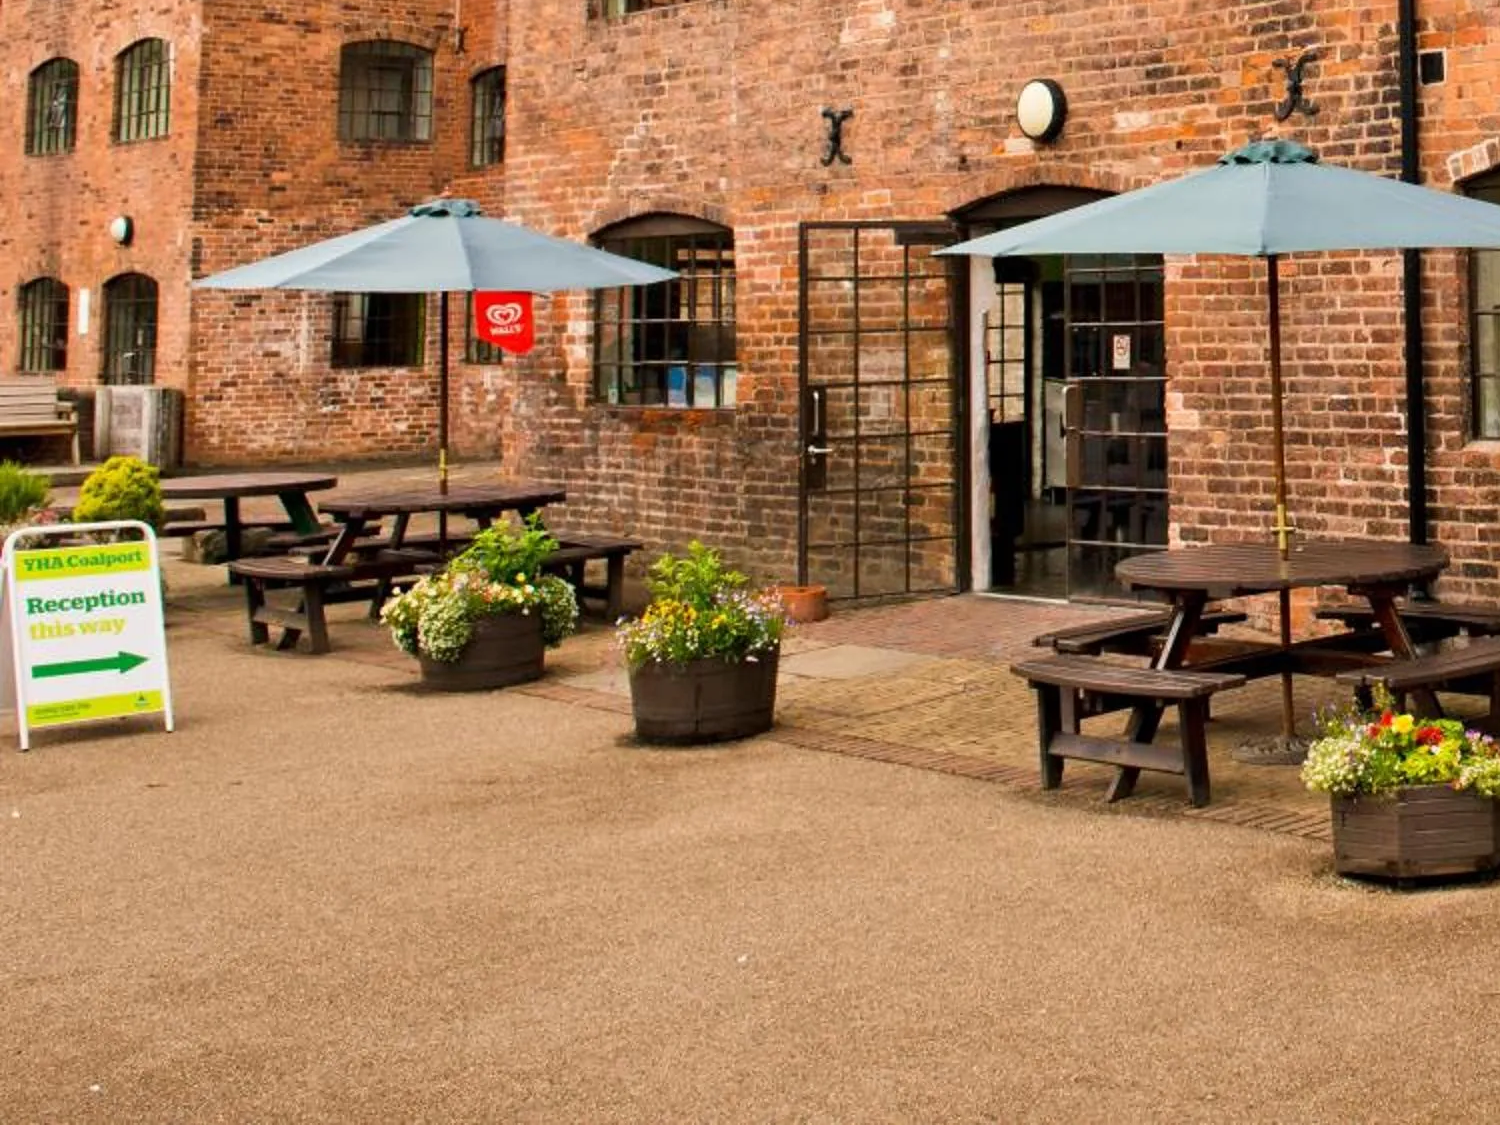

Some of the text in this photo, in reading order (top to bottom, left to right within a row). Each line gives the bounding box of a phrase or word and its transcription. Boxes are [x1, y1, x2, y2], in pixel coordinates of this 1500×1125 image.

[23, 549, 142, 572] YHA Coalport
[27, 589, 145, 614] Reception
[30, 618, 125, 640] this way
